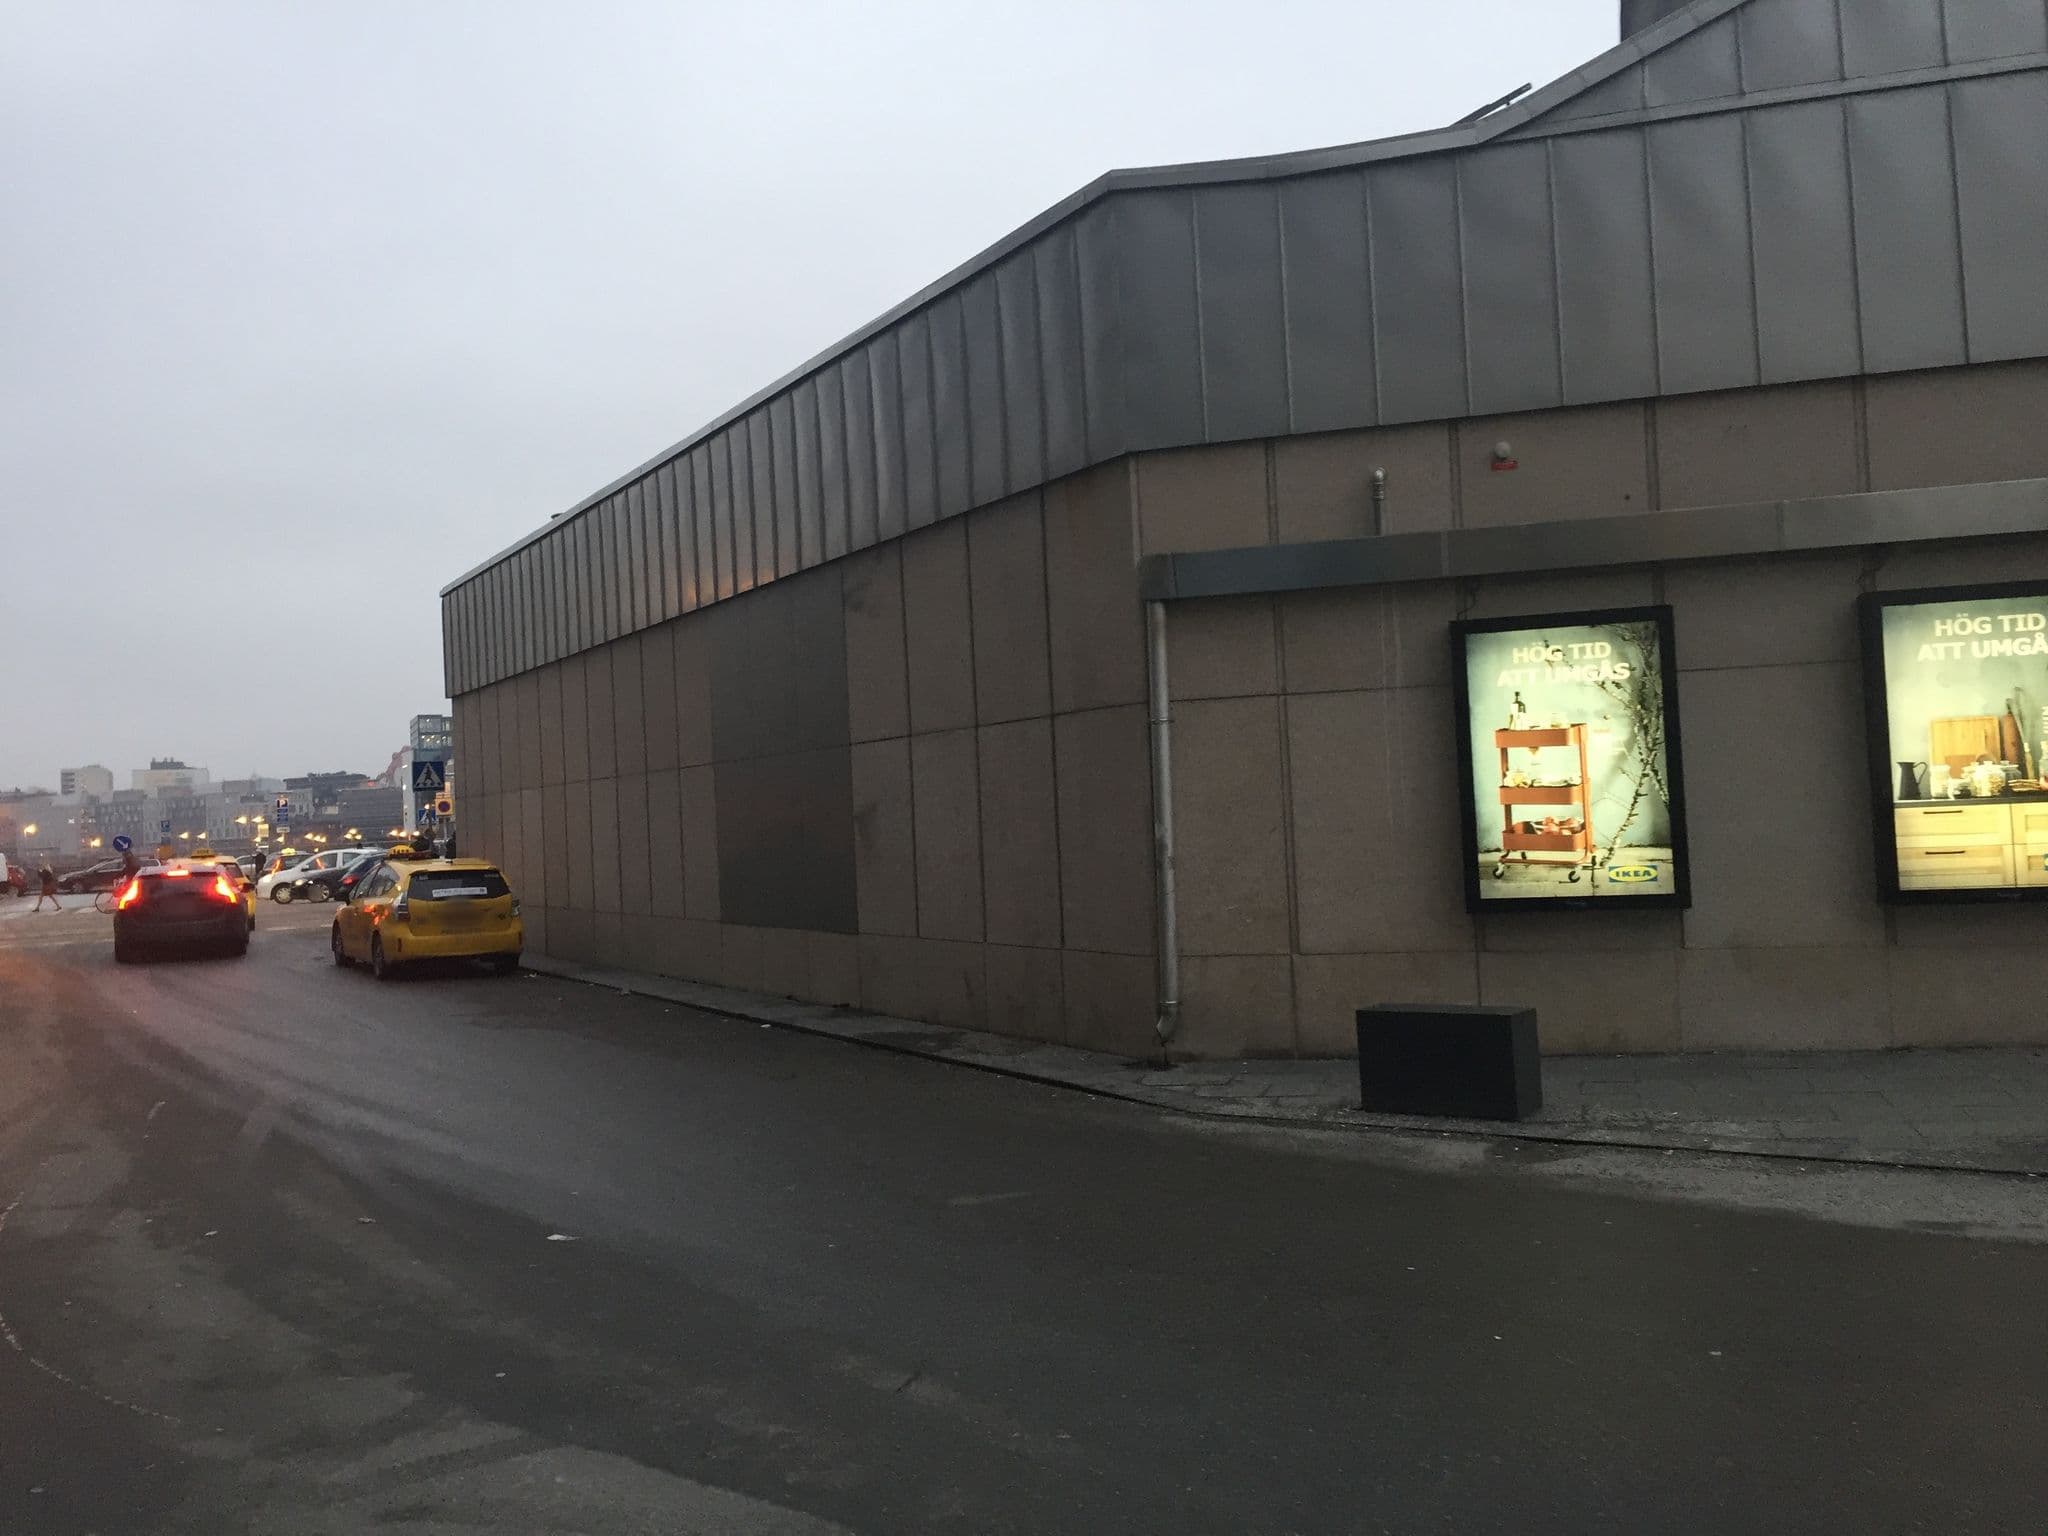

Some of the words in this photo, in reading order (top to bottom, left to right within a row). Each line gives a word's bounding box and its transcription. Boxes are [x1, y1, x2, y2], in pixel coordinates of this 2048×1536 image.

[1935, 613, 1992, 637] HÖG
[1997, 613, 2046, 633] TID
[1512, 642, 1563, 664] HÖG
[1567, 641, 1612, 660] TID
[1918, 641, 1966, 661] ATT
[1497, 667, 1538, 687] ATT
[1615, 870, 1652, 878] IKEA
